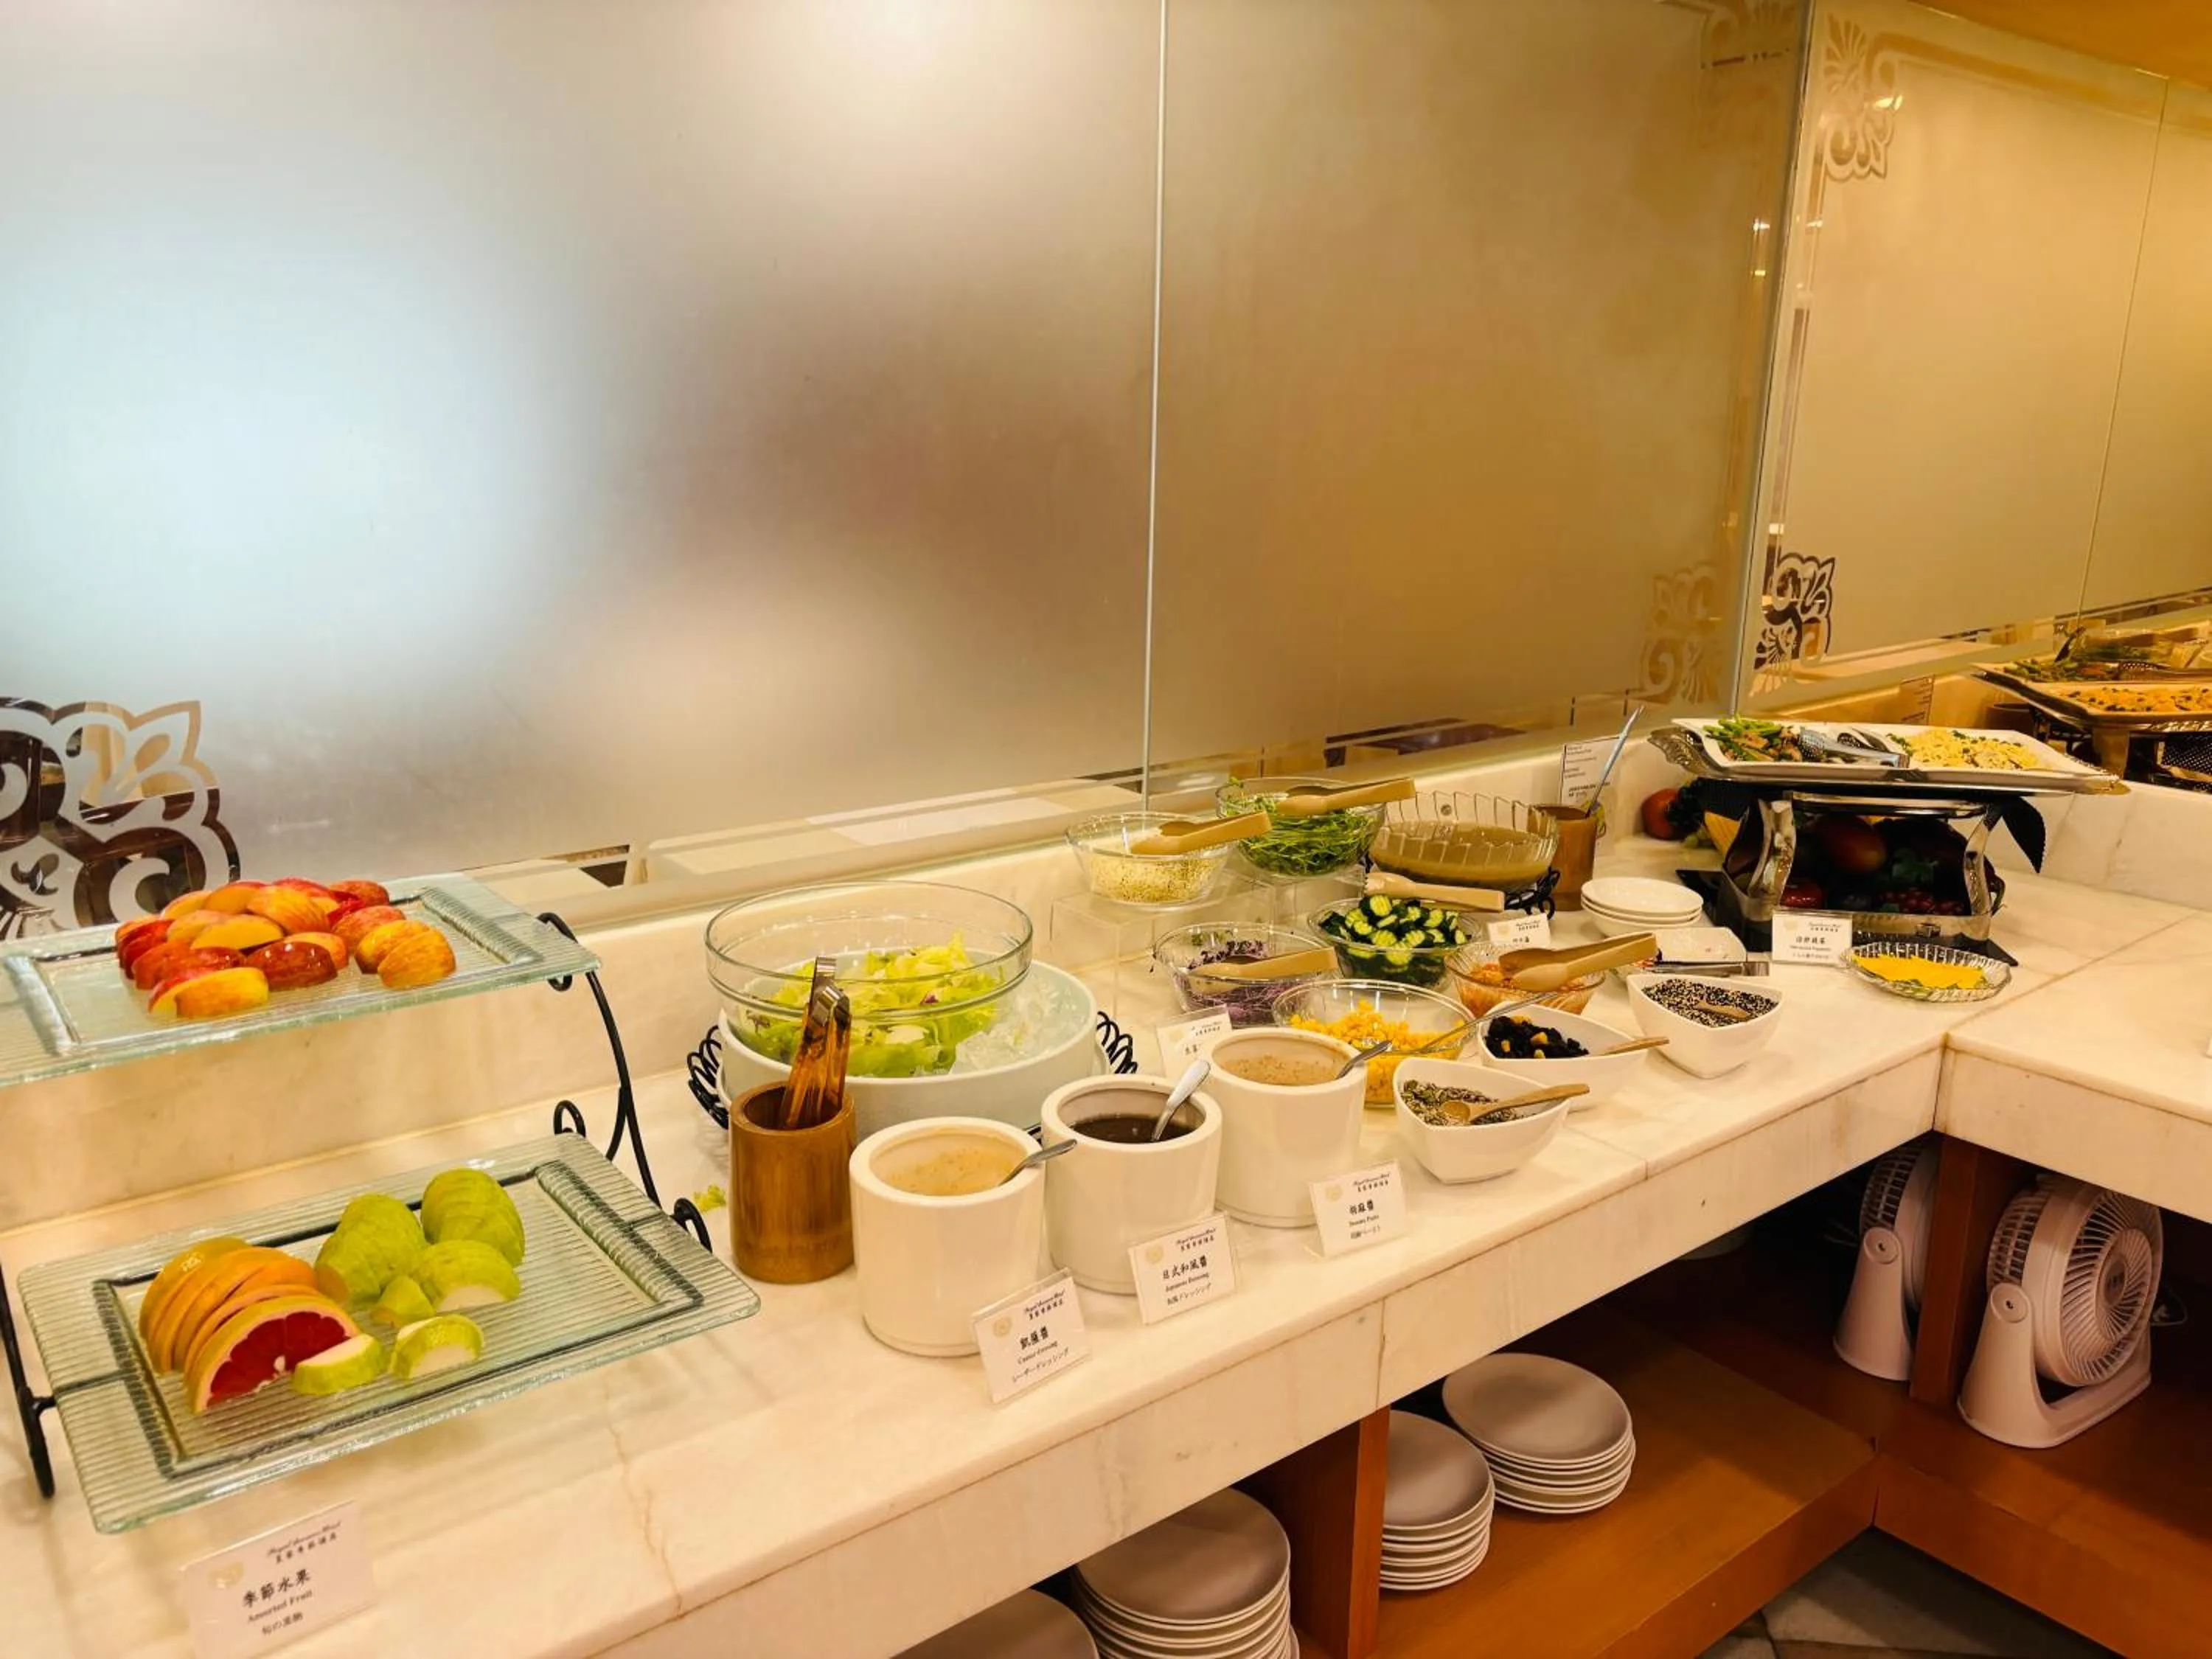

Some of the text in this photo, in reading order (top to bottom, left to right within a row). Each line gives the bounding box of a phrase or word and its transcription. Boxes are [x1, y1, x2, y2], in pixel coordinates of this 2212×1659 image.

[242, 1568, 311, 1608] 季節水果
[290, 1590, 313, 1606] Fruit
